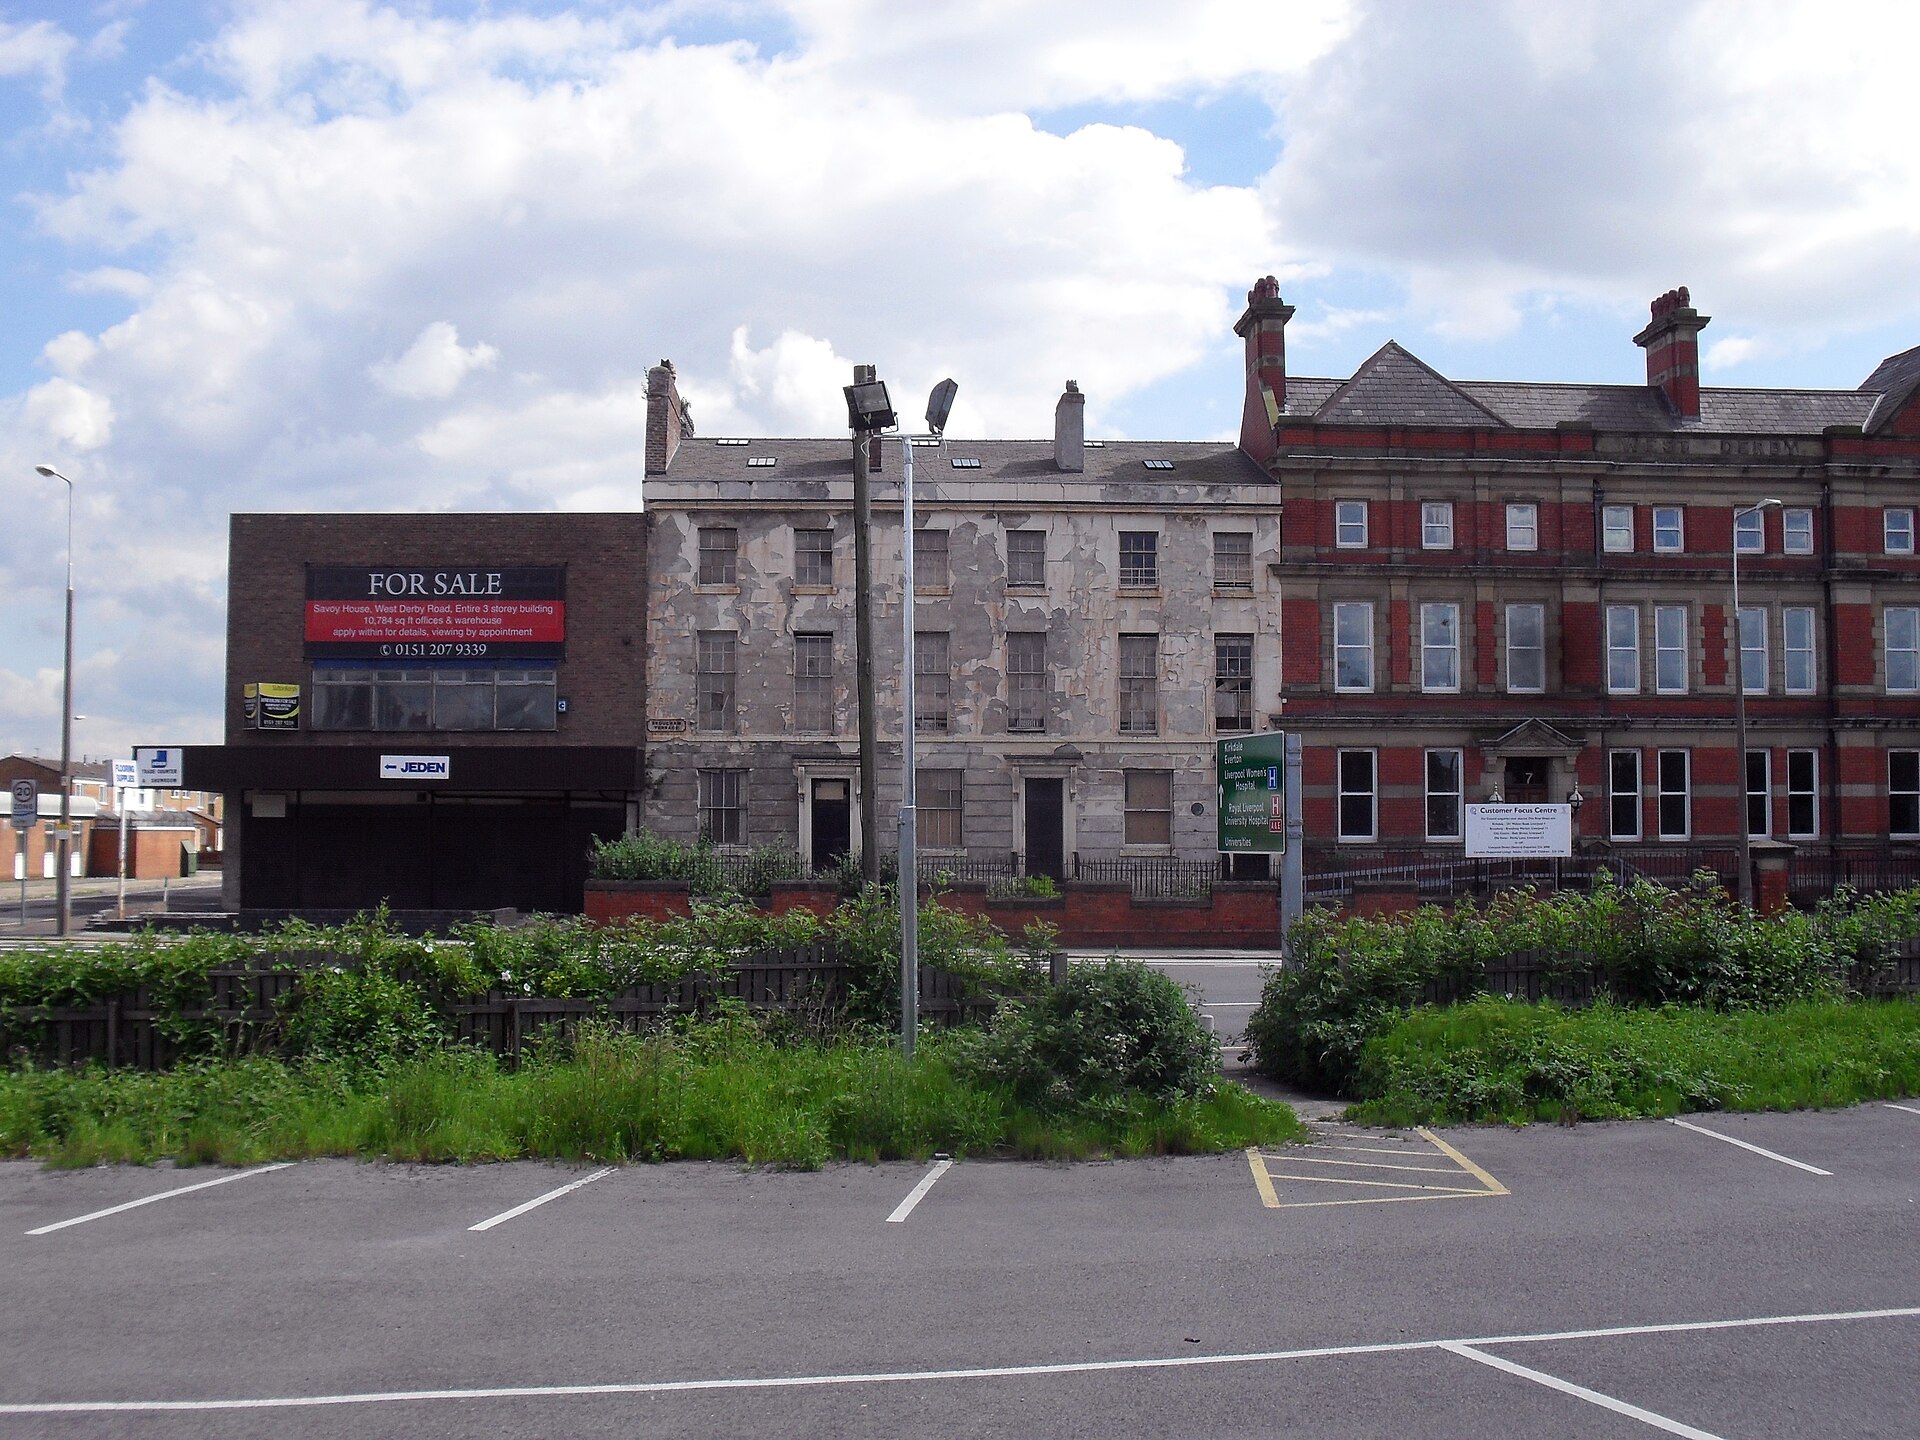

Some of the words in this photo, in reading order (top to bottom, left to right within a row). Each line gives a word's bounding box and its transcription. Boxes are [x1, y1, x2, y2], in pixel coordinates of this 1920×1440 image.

[1720, 439, 1800, 456] DERBY
[368, 573, 428, 595] FOR
[434, 573, 502, 595] SALE
[313, 604, 340, 614] Savoy
[342, 604, 372, 614] House,
[374, 604, 397, 613] West
[400, 604, 425, 614] Derby
[428, 604, 452, 614] Road,
[455, 604, 480, 613] Entire
[482, 604, 489, 613] 3
[491, 604, 518, 614] storey
[520, 604, 554, 615] building
[364, 616, 392, 626] 10,784
[394, 618, 406, 628] sq
[407, 616, 414, 625] ft
[415, 616, 444, 625] offices
[445, 616, 452, 625] &
[454, 616, 502, 625] warehouse
[333, 628, 356, 638] apply
[358, 628, 383, 636] within
[385, 628, 396, 636] for
[398, 628, 429, 638] details,
[432, 628, 464, 638] viewing
[466, 628, 477, 638] by
[479, 628, 533, 638] appointment
[395, 644, 425, 656] 0151
[429, 644, 452, 656] 207
[455, 644, 487, 656] 9339
[1224, 742, 1243, 752] Kirkdale
[1224, 755, 1242, 764] Everton
[116, 764, 134, 772] FLOORING
[400, 762, 446, 773] JEDEN
[1224, 768, 1246, 780] Liverpool
[1246, 766, 1267, 778] Women's
[1525, 772, 1534, 785] 7
[16, 787, 31, 796] 20
[1235, 780, 1256, 792] Hospital
[1228, 803, 1242, 814] Royal
[1242, 802, 1264, 814] Liverpool
[1224, 816, 1248, 828] University
[1248, 815, 1269, 826] Hospital
[1224, 837, 1252, 847] Universities
